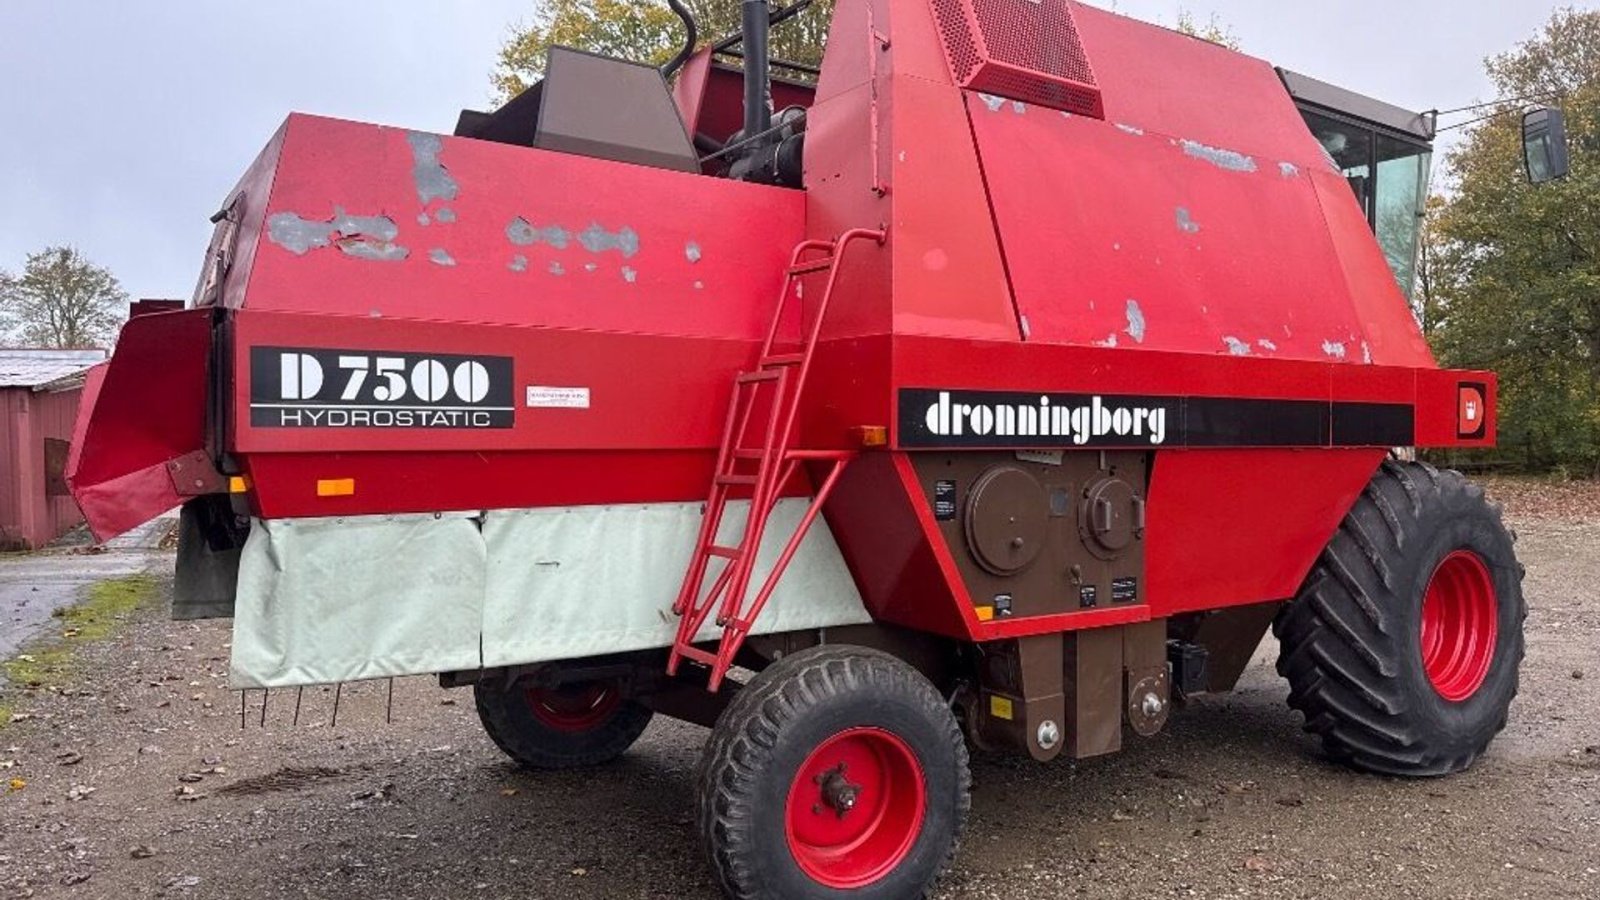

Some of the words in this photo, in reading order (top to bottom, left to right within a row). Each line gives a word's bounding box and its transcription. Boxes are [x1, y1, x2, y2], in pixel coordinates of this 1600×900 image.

[281, 353, 324, 400] D
[339, 356, 490, 403] 7500
[281, 409, 491, 427] HYDROSTATIC
[925, 391, 1166, 445] dronningborg
